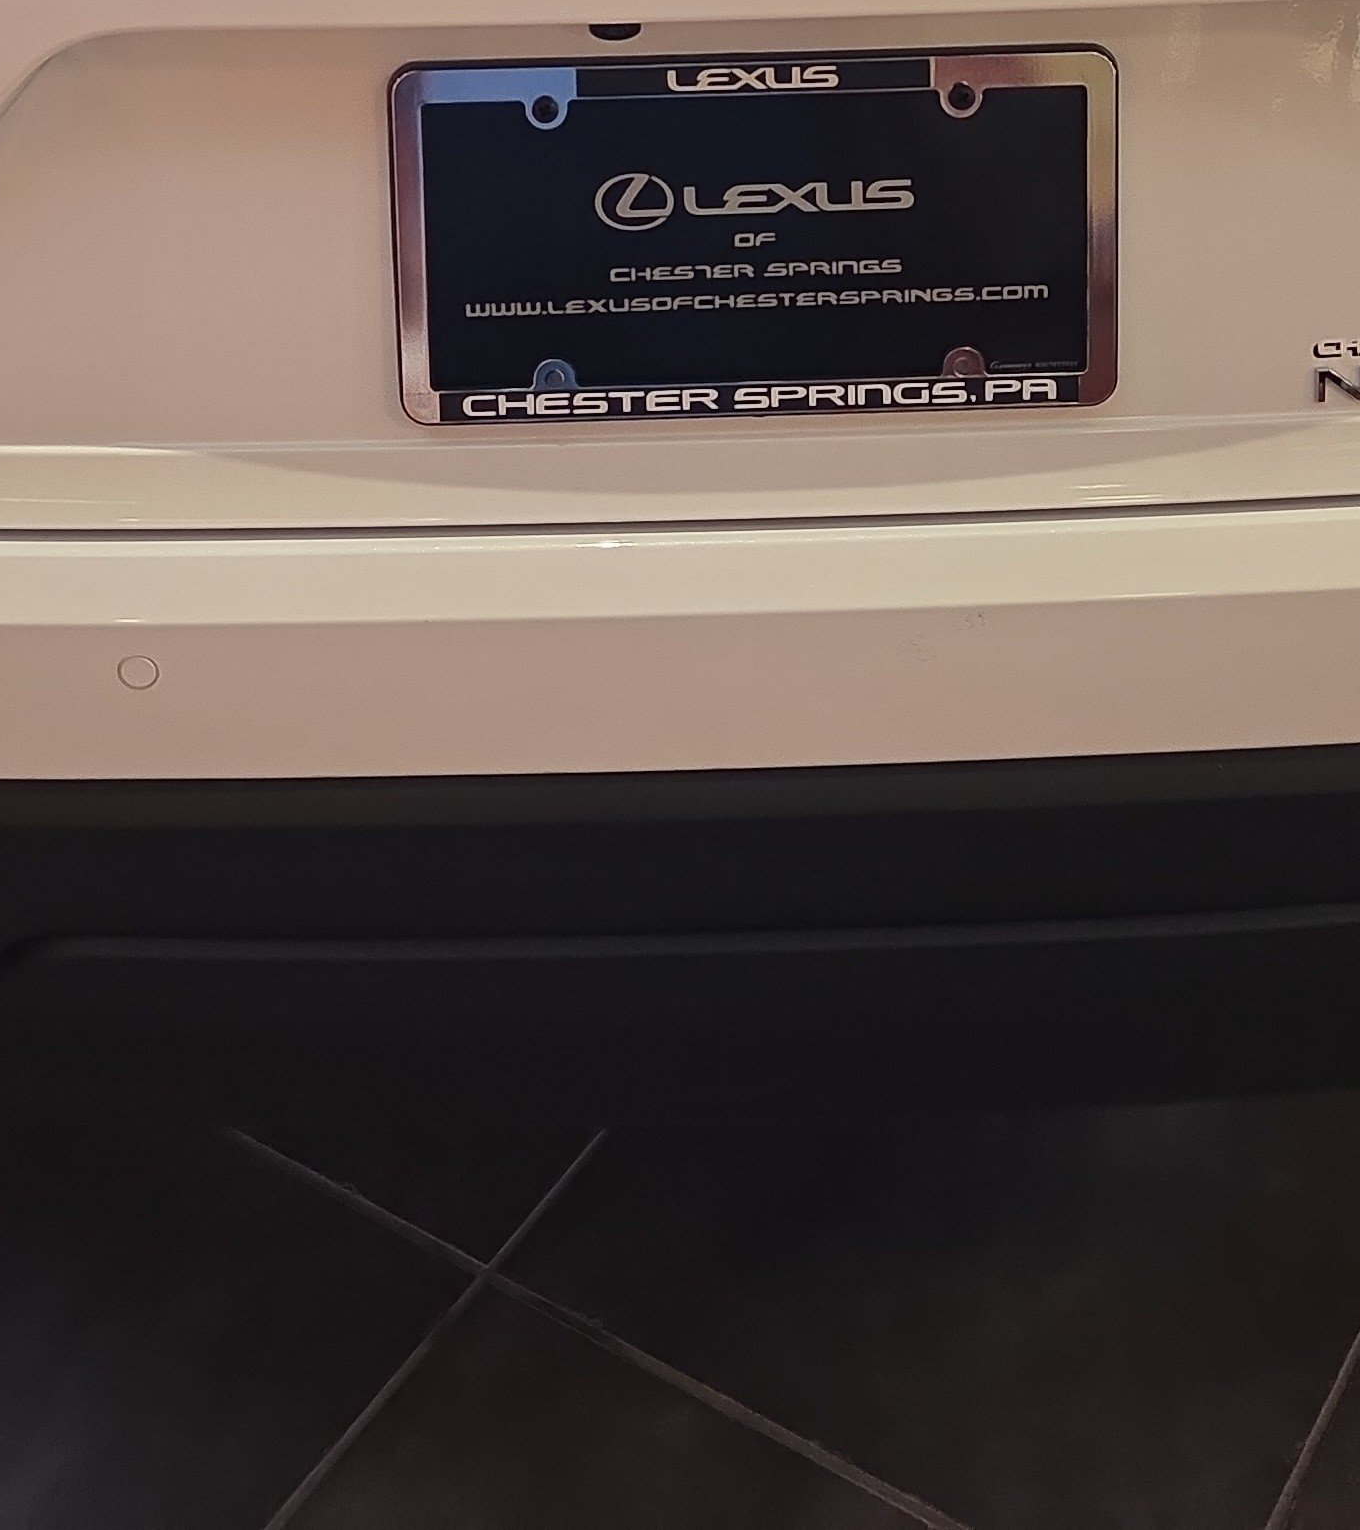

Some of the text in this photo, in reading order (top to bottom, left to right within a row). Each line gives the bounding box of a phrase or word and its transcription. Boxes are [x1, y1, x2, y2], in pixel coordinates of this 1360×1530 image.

[667, 65, 839, 92] LEXUS
[683, 179, 915, 216] LEXUS
[734, 232, 776, 248] OF
[609, 258, 902, 282] CHESTER SPRINGS
[462, 388, 719, 417] CHESTER
